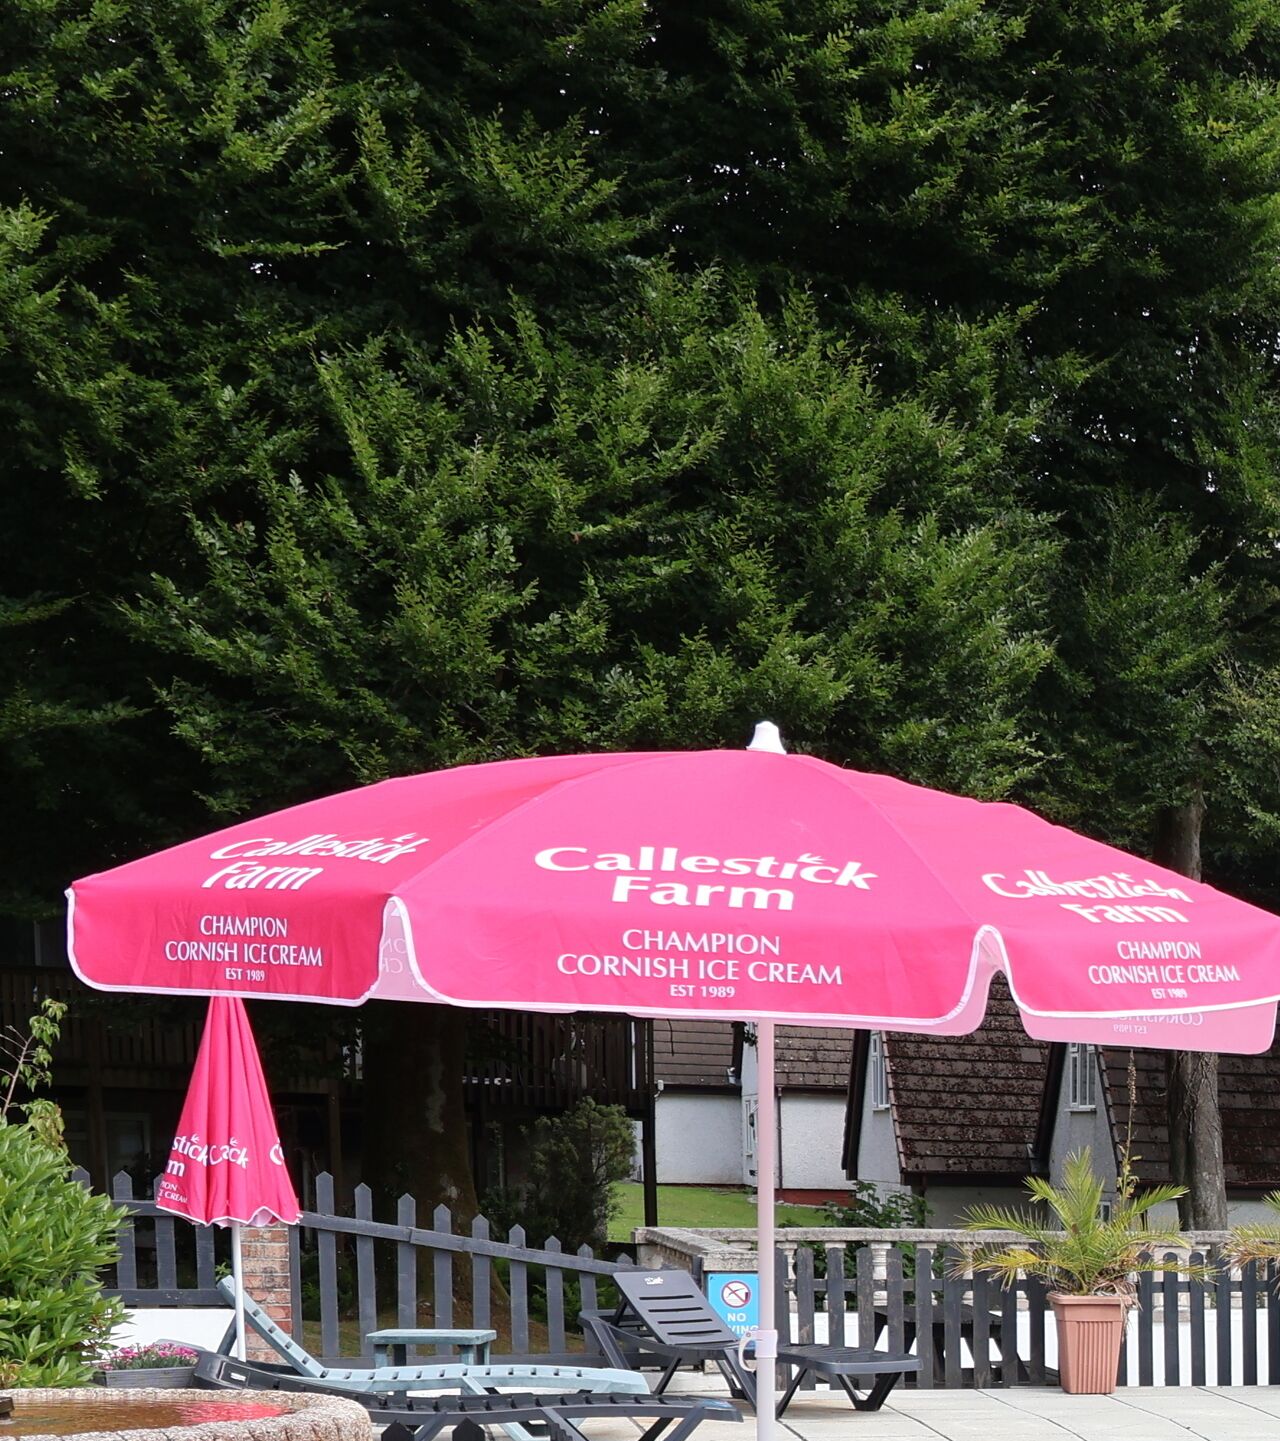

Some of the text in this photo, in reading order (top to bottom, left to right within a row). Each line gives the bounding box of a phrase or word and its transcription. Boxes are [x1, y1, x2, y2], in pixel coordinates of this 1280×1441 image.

[210, 832, 430, 864] Callestick
[201, 861, 324, 890] Farm
[534, 846, 879, 890] Callestick
[612, 875, 795, 910] Farm
[1059, 903, 1190, 923] Farm
[200, 915, 288, 938] CHAMPION
[165, 940, 322, 967] CORNISH ICE CREAM
[622, 929, 780, 955] CHAMPION
[1116, 941, 1201, 959] CHAMPION
[225, 968, 265, 982] EST 1989
[557, 953, 843, 985] CORNISH ICE CREAM
[1088, 965, 1240, 984] CORNISH ICE CREAM
[669, 984, 735, 999] EST 1989
[1151, 988, 1165, 999] EST
[727, 1312, 746, 1322] NO
